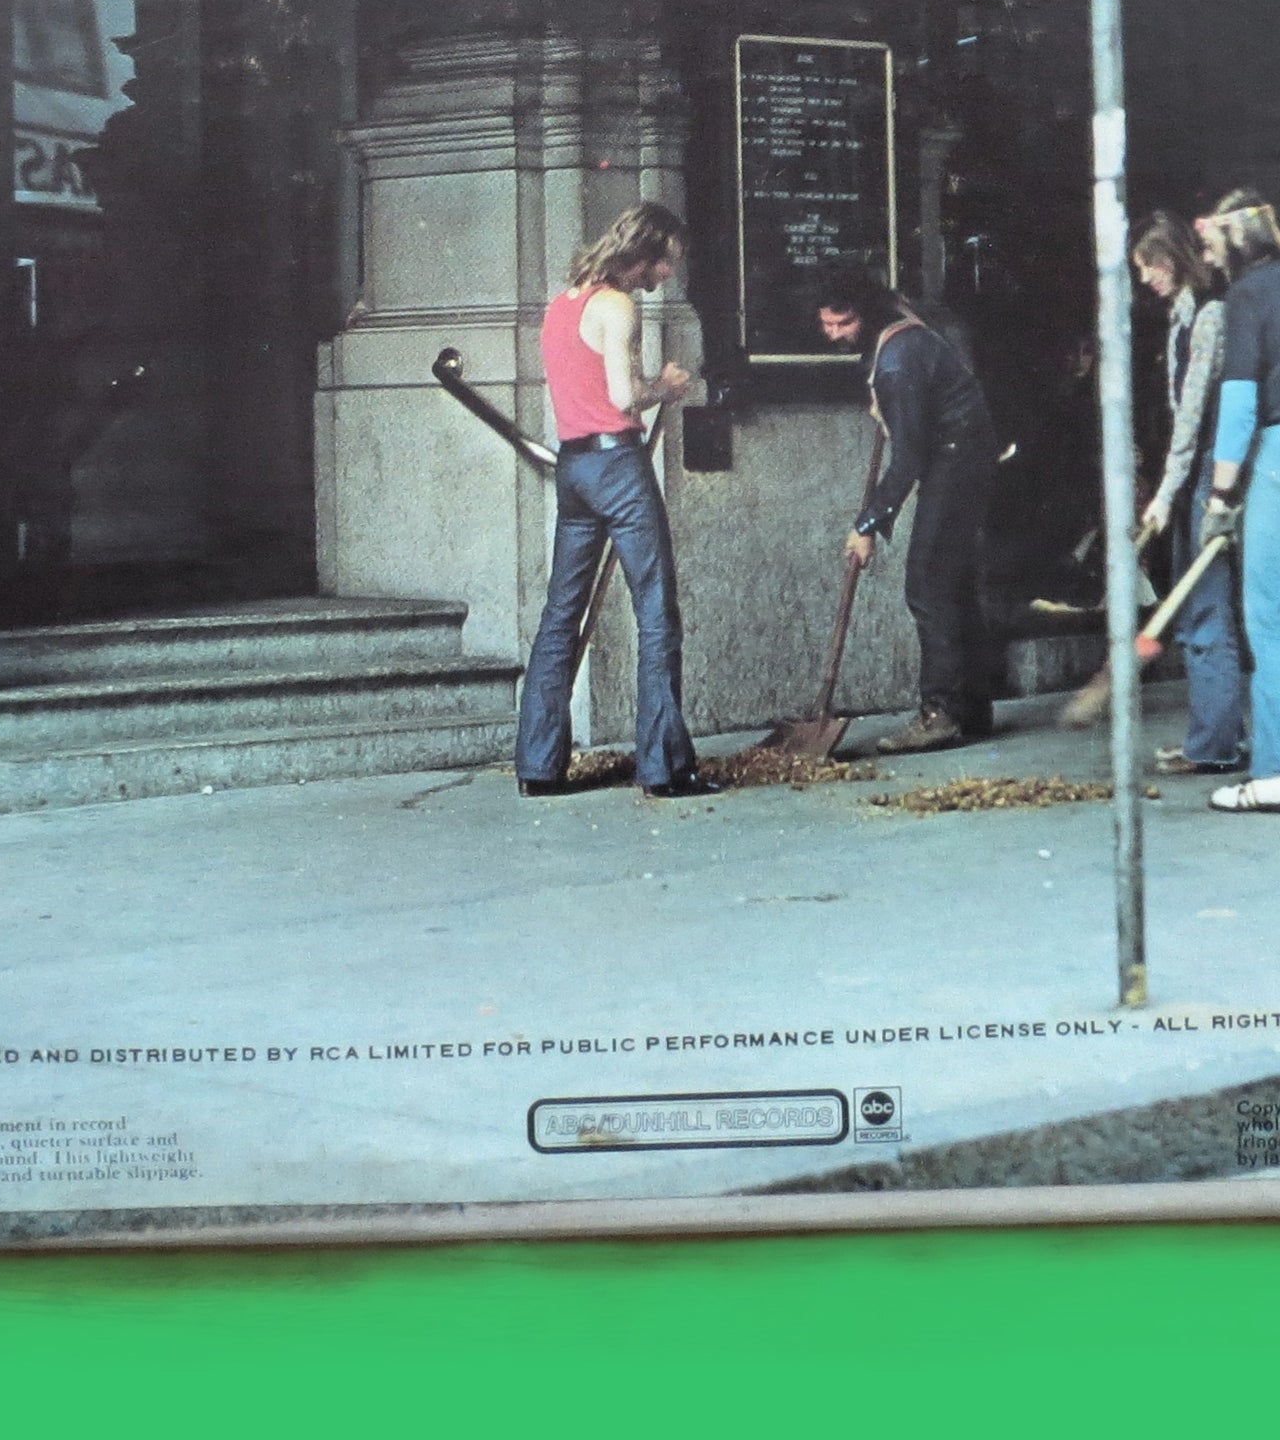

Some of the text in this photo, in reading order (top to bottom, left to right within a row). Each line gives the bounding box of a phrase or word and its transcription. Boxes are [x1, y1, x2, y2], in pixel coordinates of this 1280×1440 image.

[30, 1047, 81, 1063] AND
[89, 1046, 257, 1064] DISTRIBUTED
[266, 1046, 299, 1062] BY
[309, 1045, 360, 1062] RCA
[368, 1042, 473, 1060] LIMITED
[482, 1040, 532, 1057] FOR
[541, 1037, 636, 1055] PUBLIC
[645, 1029, 835, 1052] PERFORMANCE
[845, 1026, 930, 1044] UNDER
[938, 1022, 1047, 1042] LICENSE
[1055, 1020, 1123, 1036] ONLY
[1152, 1016, 1199, 1033] ALL
[862, 1099, 893, 1115] abc
[49, 1117, 66, 1132] in
[71, 1116, 127, 1132] record
[715, 1106, 835, 1132] RECORDS
[10, 1136, 71, 1153] quieter
[79, 1132, 139, 1148] surface
[146, 1131, 178, 1147] and
[54, 1150, 90, 1165] This
[96, 1148, 195, 1167] lightweight
[1236, 1150, 1258, 1169] by
[1, 1167, 33, 1183] and
[39, 1166, 121, 1183] turntable
[126, 1164, 204, 1184] slippage.
